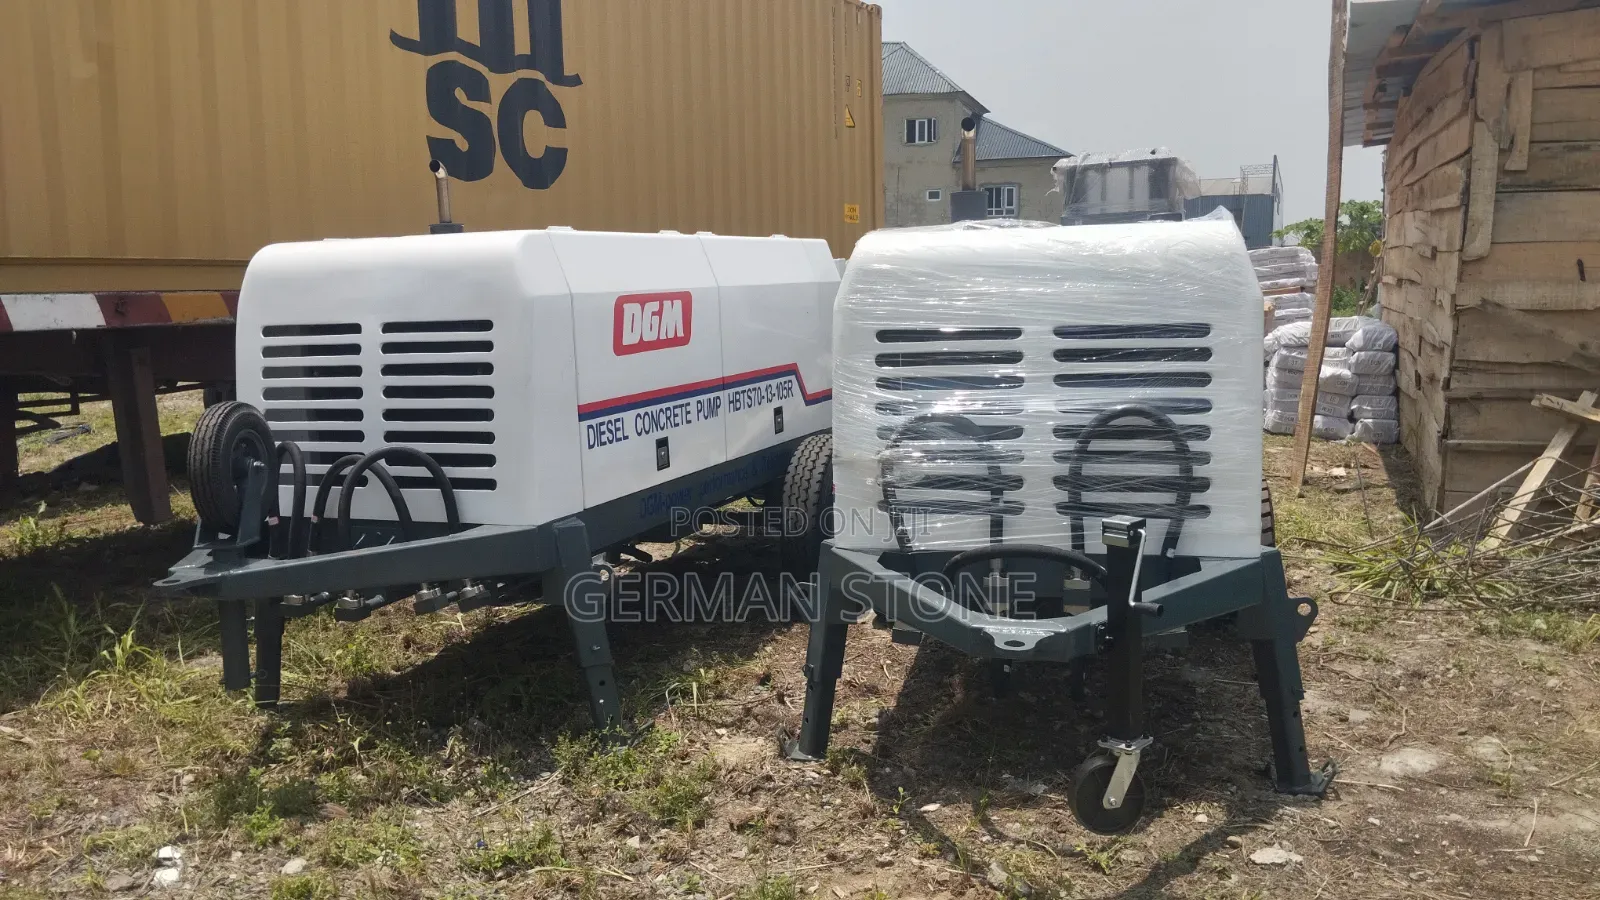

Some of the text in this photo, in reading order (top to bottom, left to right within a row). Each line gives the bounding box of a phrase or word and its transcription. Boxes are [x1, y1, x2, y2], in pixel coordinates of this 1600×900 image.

[622, 299, 685, 346] DGM
[586, 379, 794, 450] DIESEL CONCRETE PUMP HBTS70-13-105R
